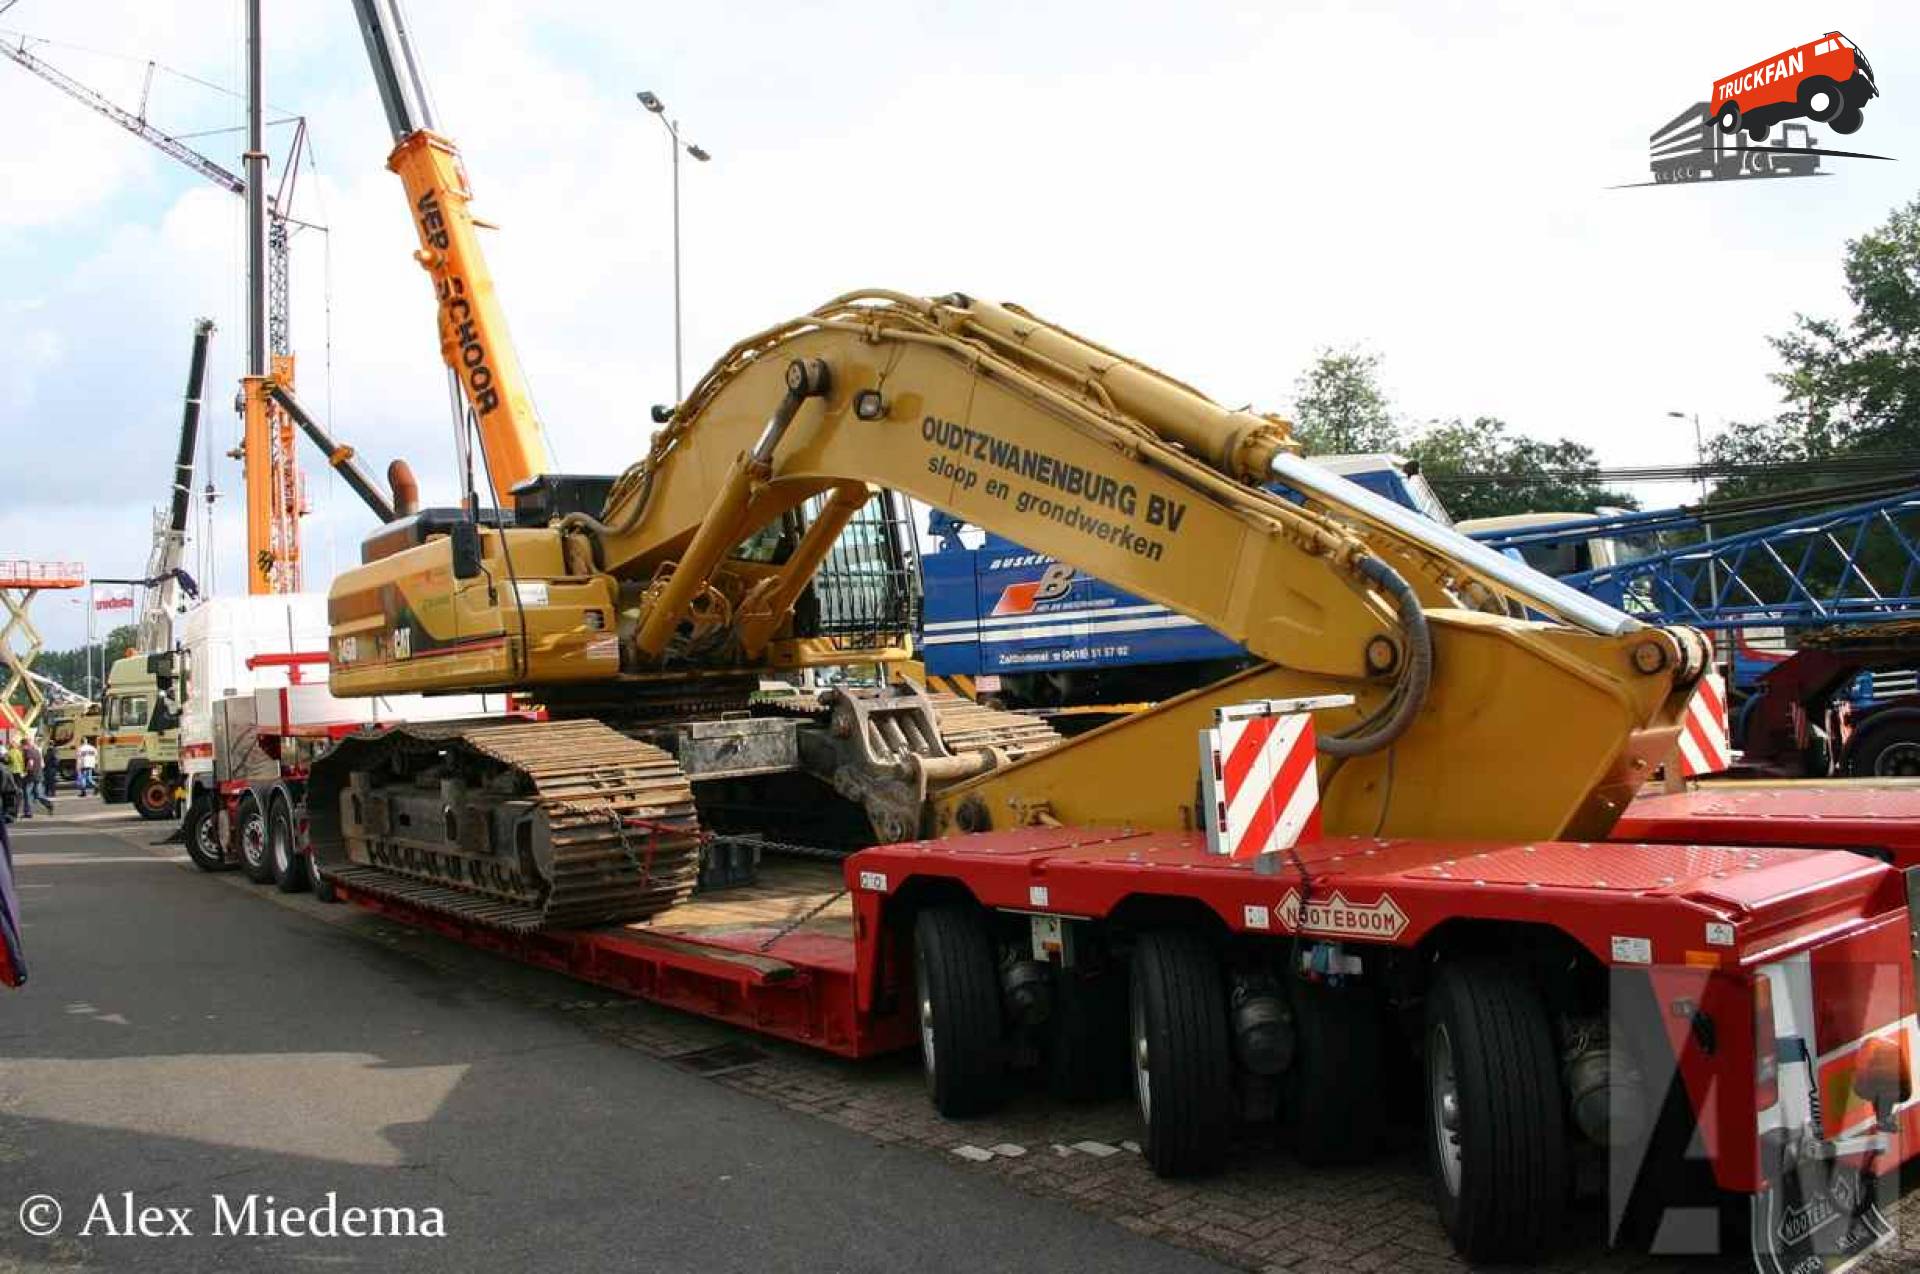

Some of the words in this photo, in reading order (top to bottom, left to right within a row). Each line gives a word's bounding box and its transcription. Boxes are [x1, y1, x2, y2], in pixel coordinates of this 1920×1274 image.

[921, 415, 1137, 518] OUDTZWANENBURG
[1145, 493, 1187, 533] BV
[927, 455, 978, 491] sloop
[984, 477, 1010, 501] en
[1015, 490, 1163, 562] grondwerken
[394, 627, 412, 659] CAT
[1286, 906, 1396, 932] NOOTEBOOM
